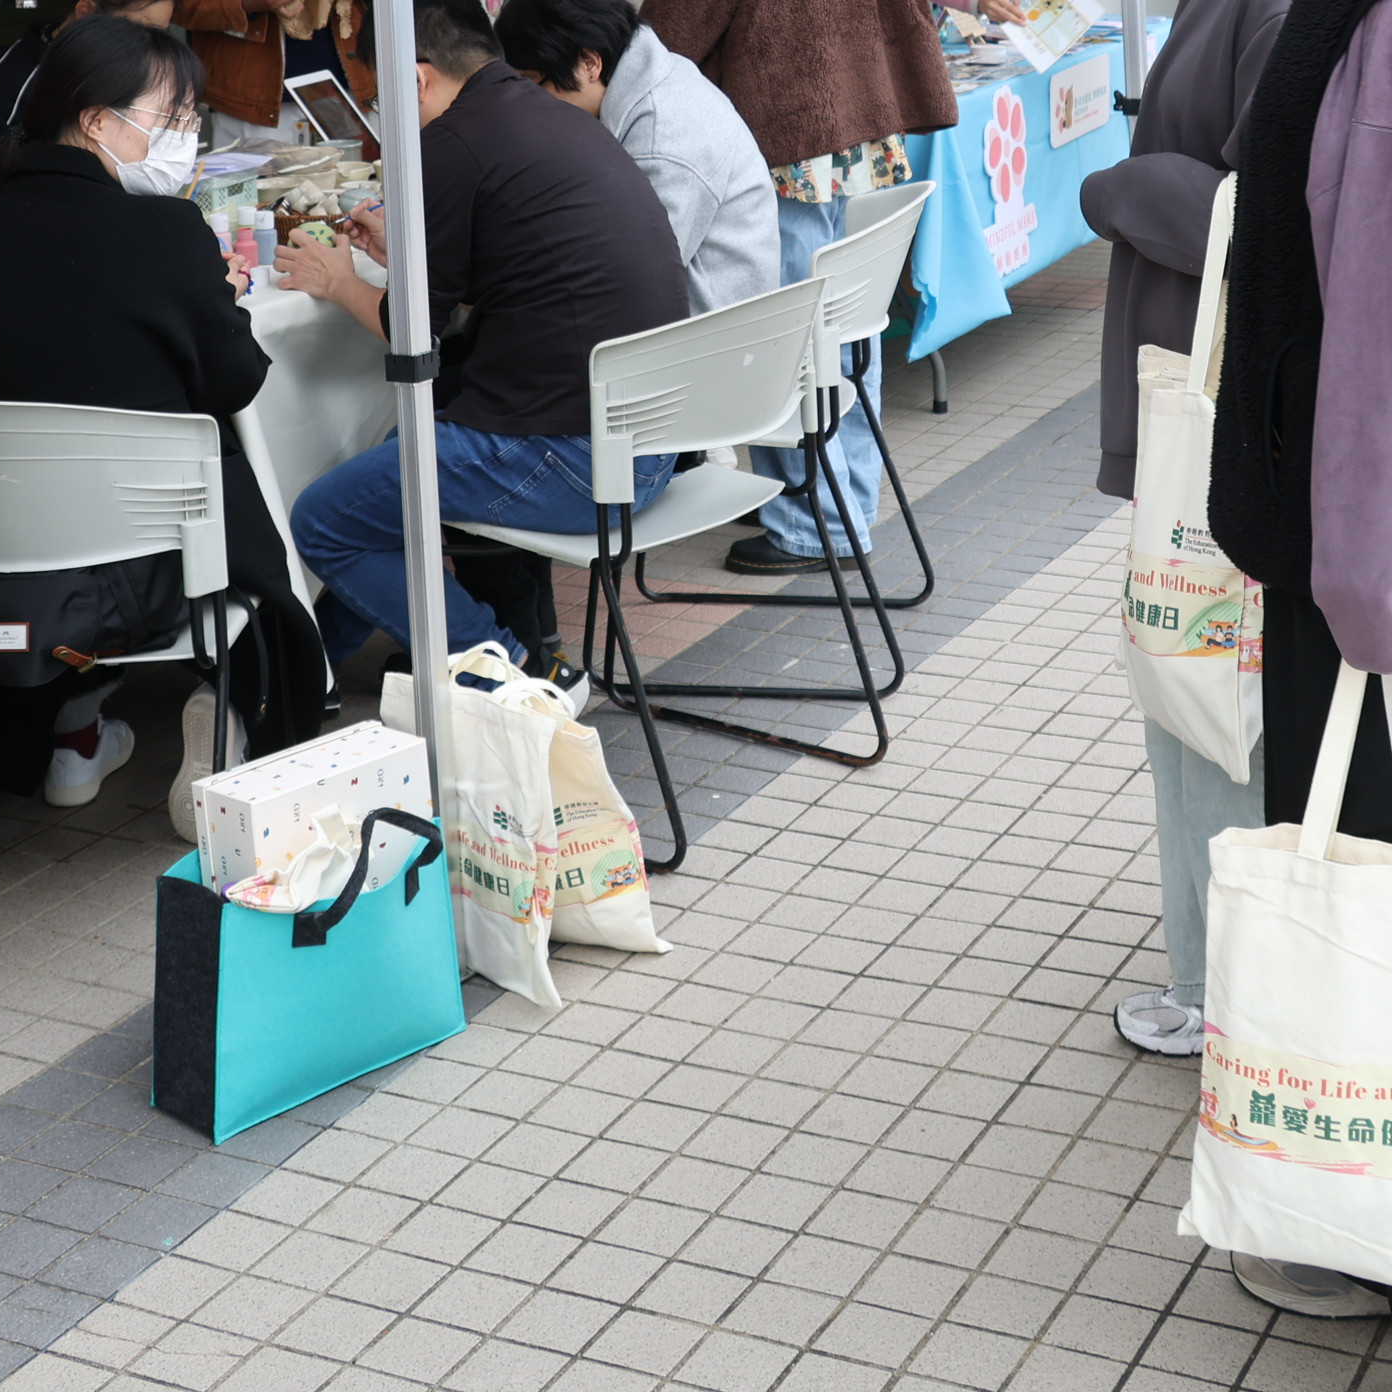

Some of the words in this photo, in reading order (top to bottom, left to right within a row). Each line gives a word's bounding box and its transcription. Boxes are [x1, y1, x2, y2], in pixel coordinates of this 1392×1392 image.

[1202, 548, 1217, 557] Kong
[1133, 570, 1155, 587] and
[1160, 573, 1227, 597] Wellness
[471, 839, 486, 857] and
[490, 847, 536, 872] Wellness
[560, 836, 615, 858] ellness
[1205, 1041, 1271, 1088] Caring
[1278, 1067, 1314, 1091] for
[1320, 1079, 1367, 1102] Life
